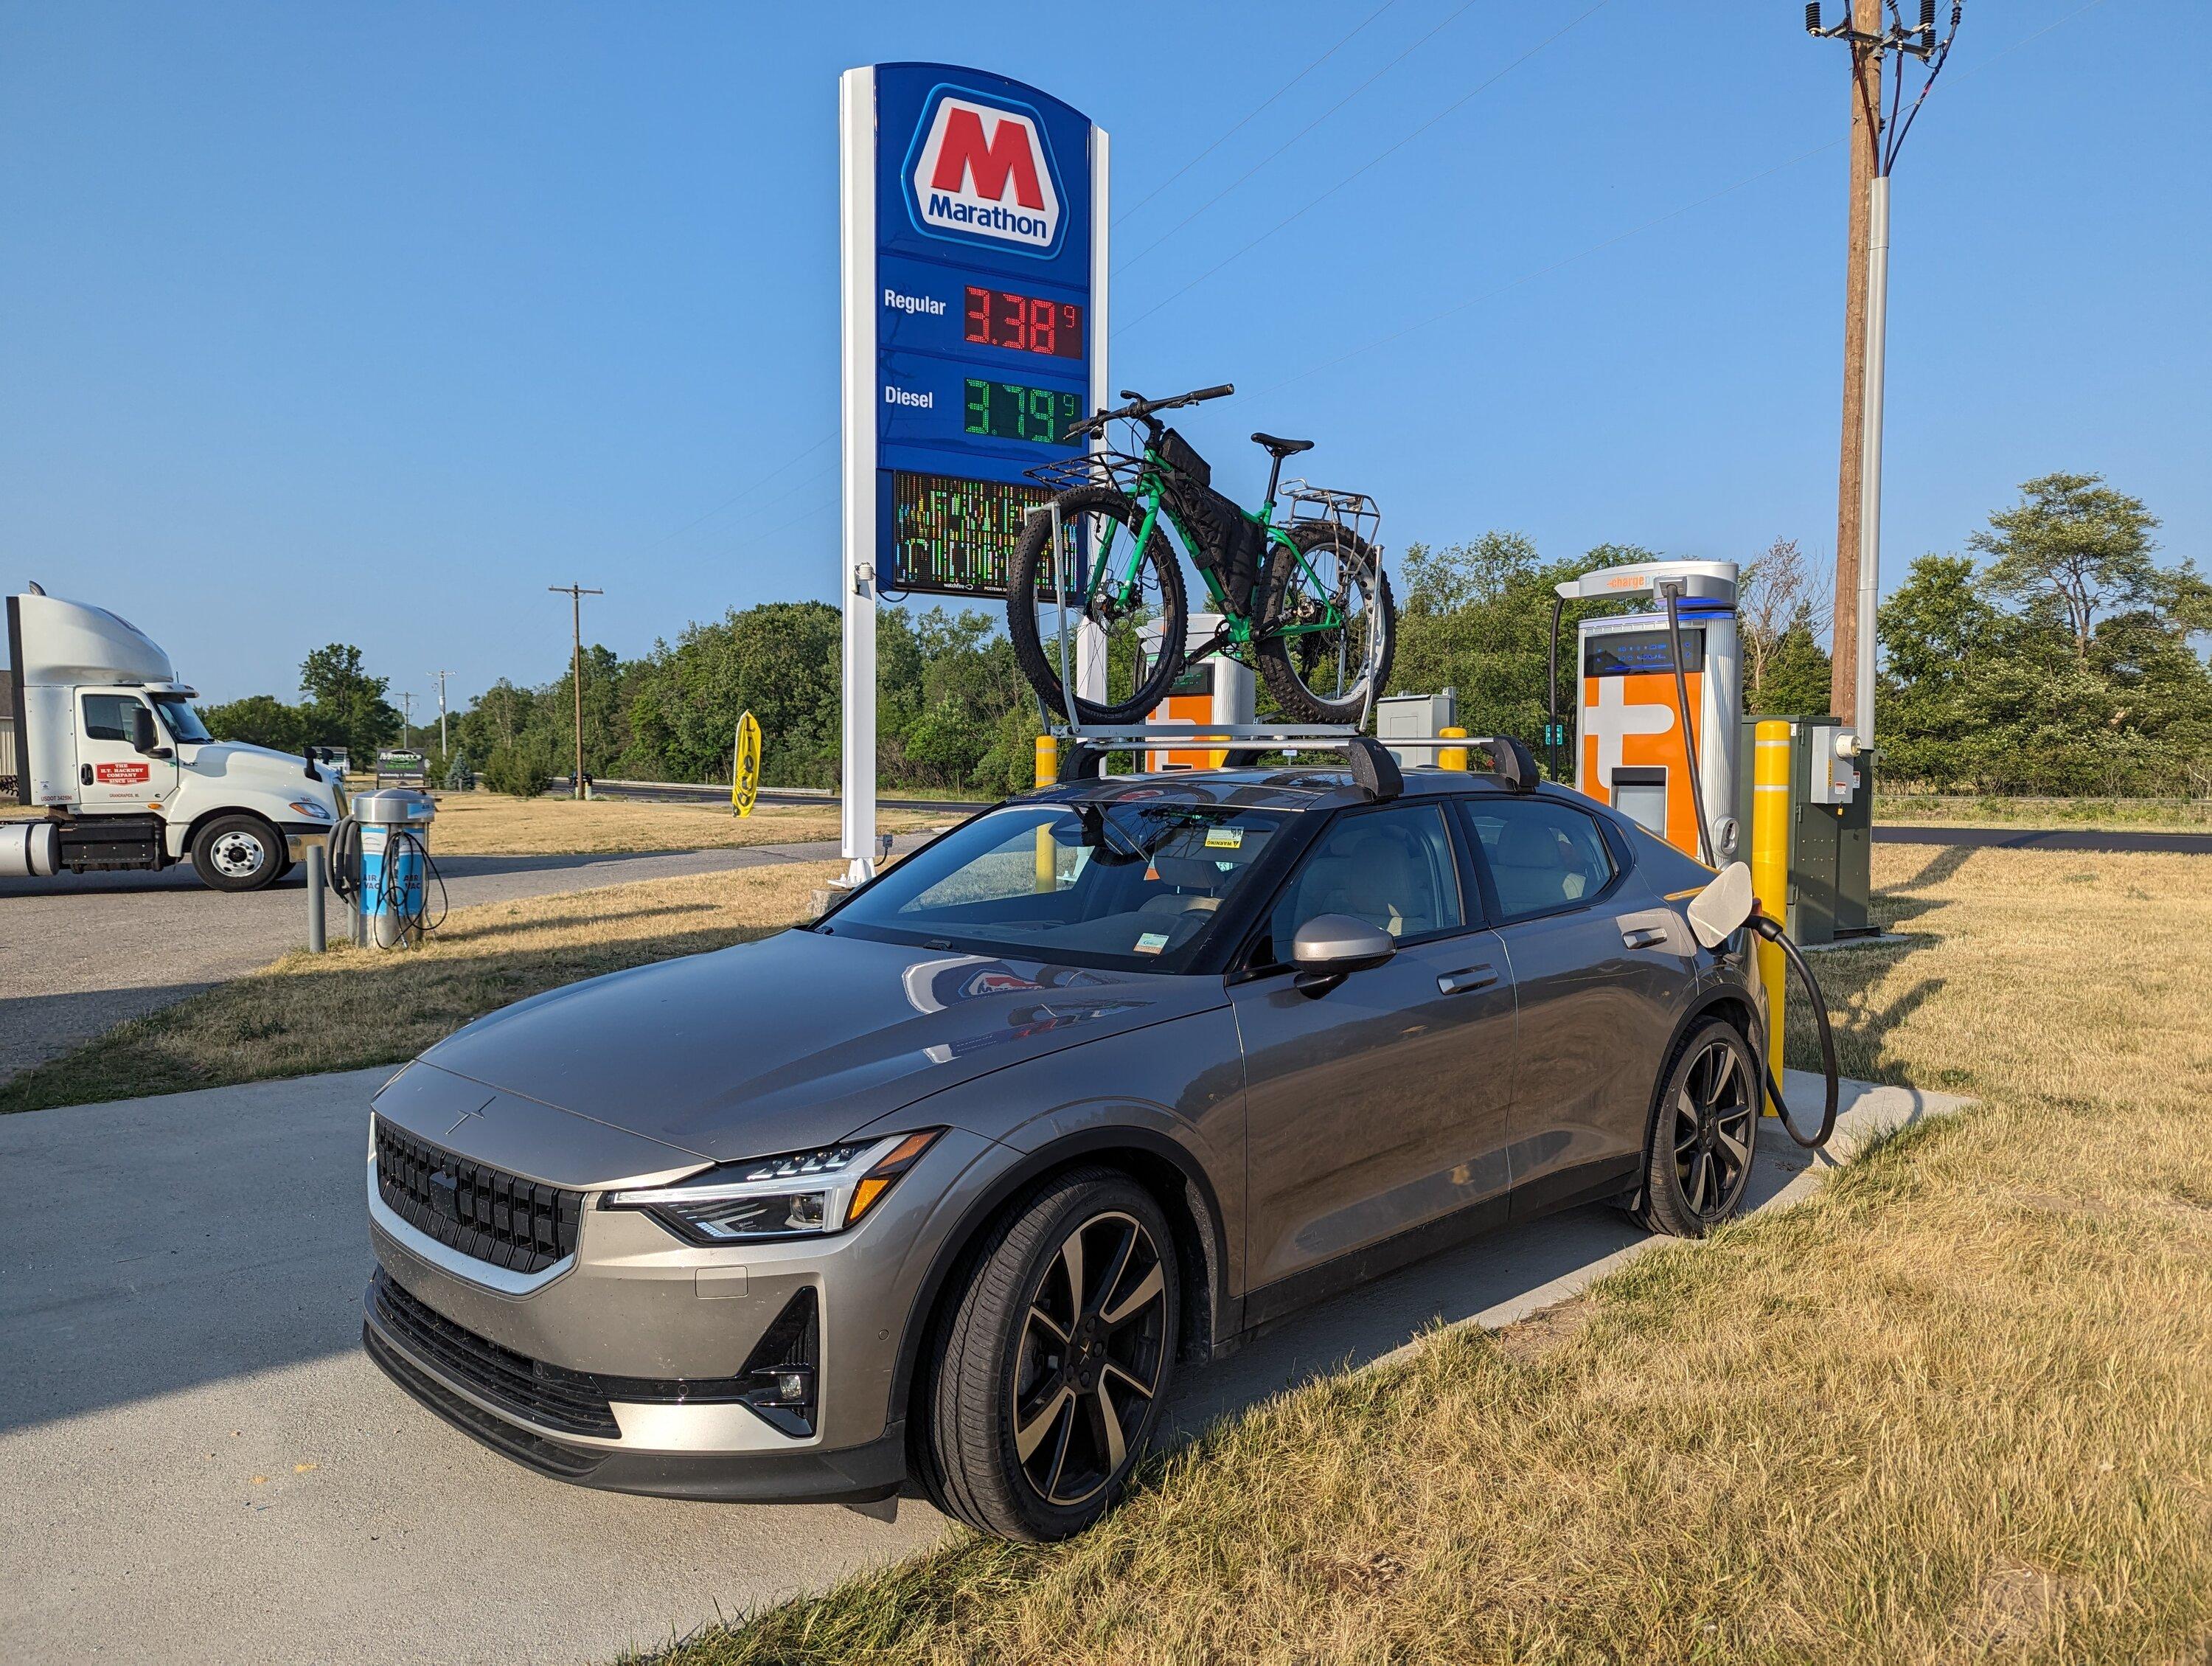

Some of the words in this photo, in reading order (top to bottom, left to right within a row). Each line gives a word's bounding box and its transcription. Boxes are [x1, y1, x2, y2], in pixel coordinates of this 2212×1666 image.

[931, 107, 1046, 211] M
[928, 193, 1046, 239] Marathon
[885, 289, 946, 315] Regular
[886, 386, 933, 409] Diesel
